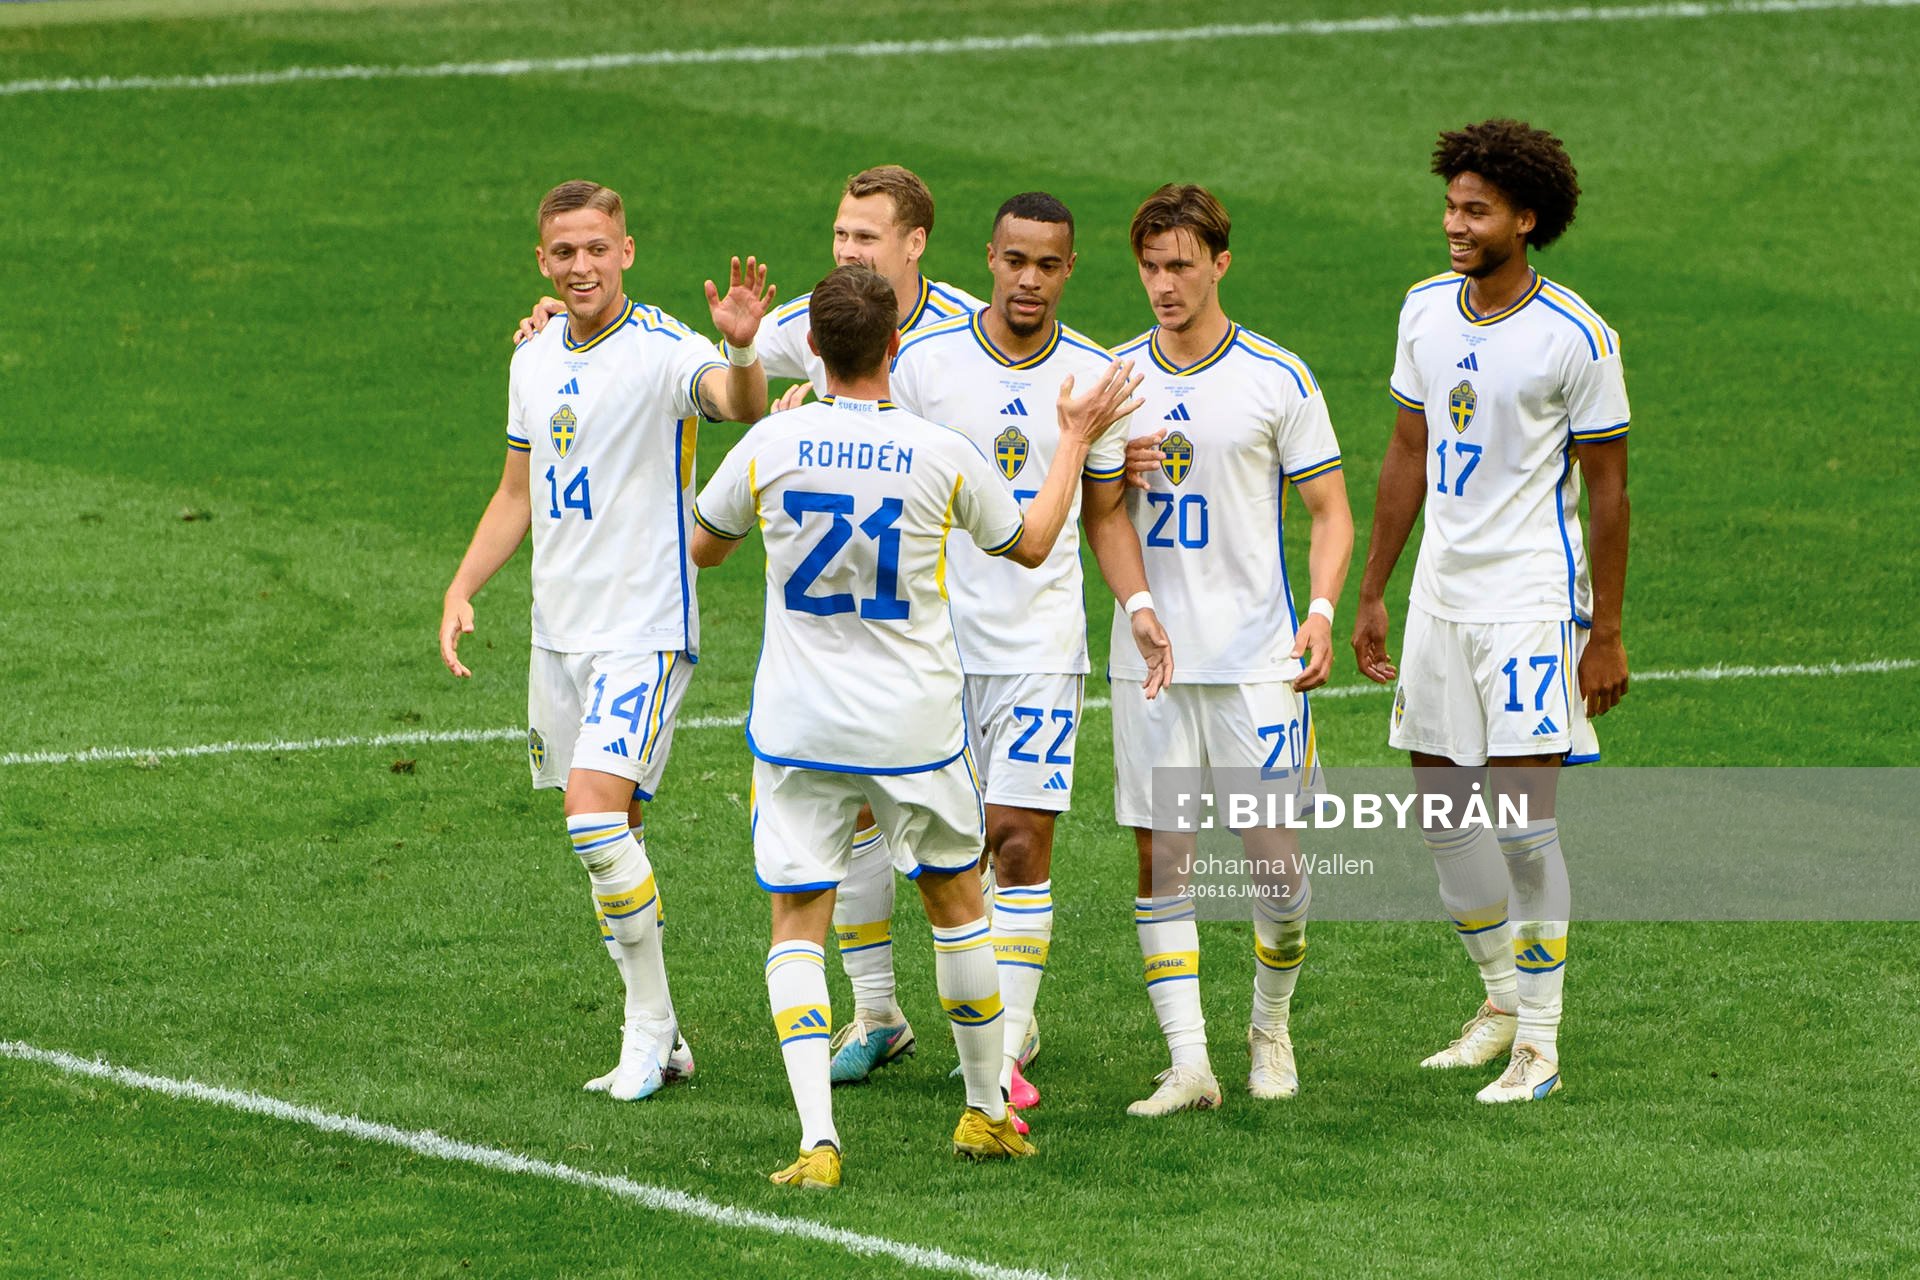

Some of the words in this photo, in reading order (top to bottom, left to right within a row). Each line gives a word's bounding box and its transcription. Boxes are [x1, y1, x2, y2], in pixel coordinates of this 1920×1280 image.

[799, 440, 914, 475] ROHDÉN
[1436, 439, 1483, 497] 17
[545, 465, 593, 521] 14
[1146, 492, 1209, 549] 20
[782, 490, 910, 621] 21
[586, 673, 649, 734] 14
[1502, 654, 1558, 711] 17
[1007, 706, 1074, 765] 22
[1257, 718, 1301, 781] 20
